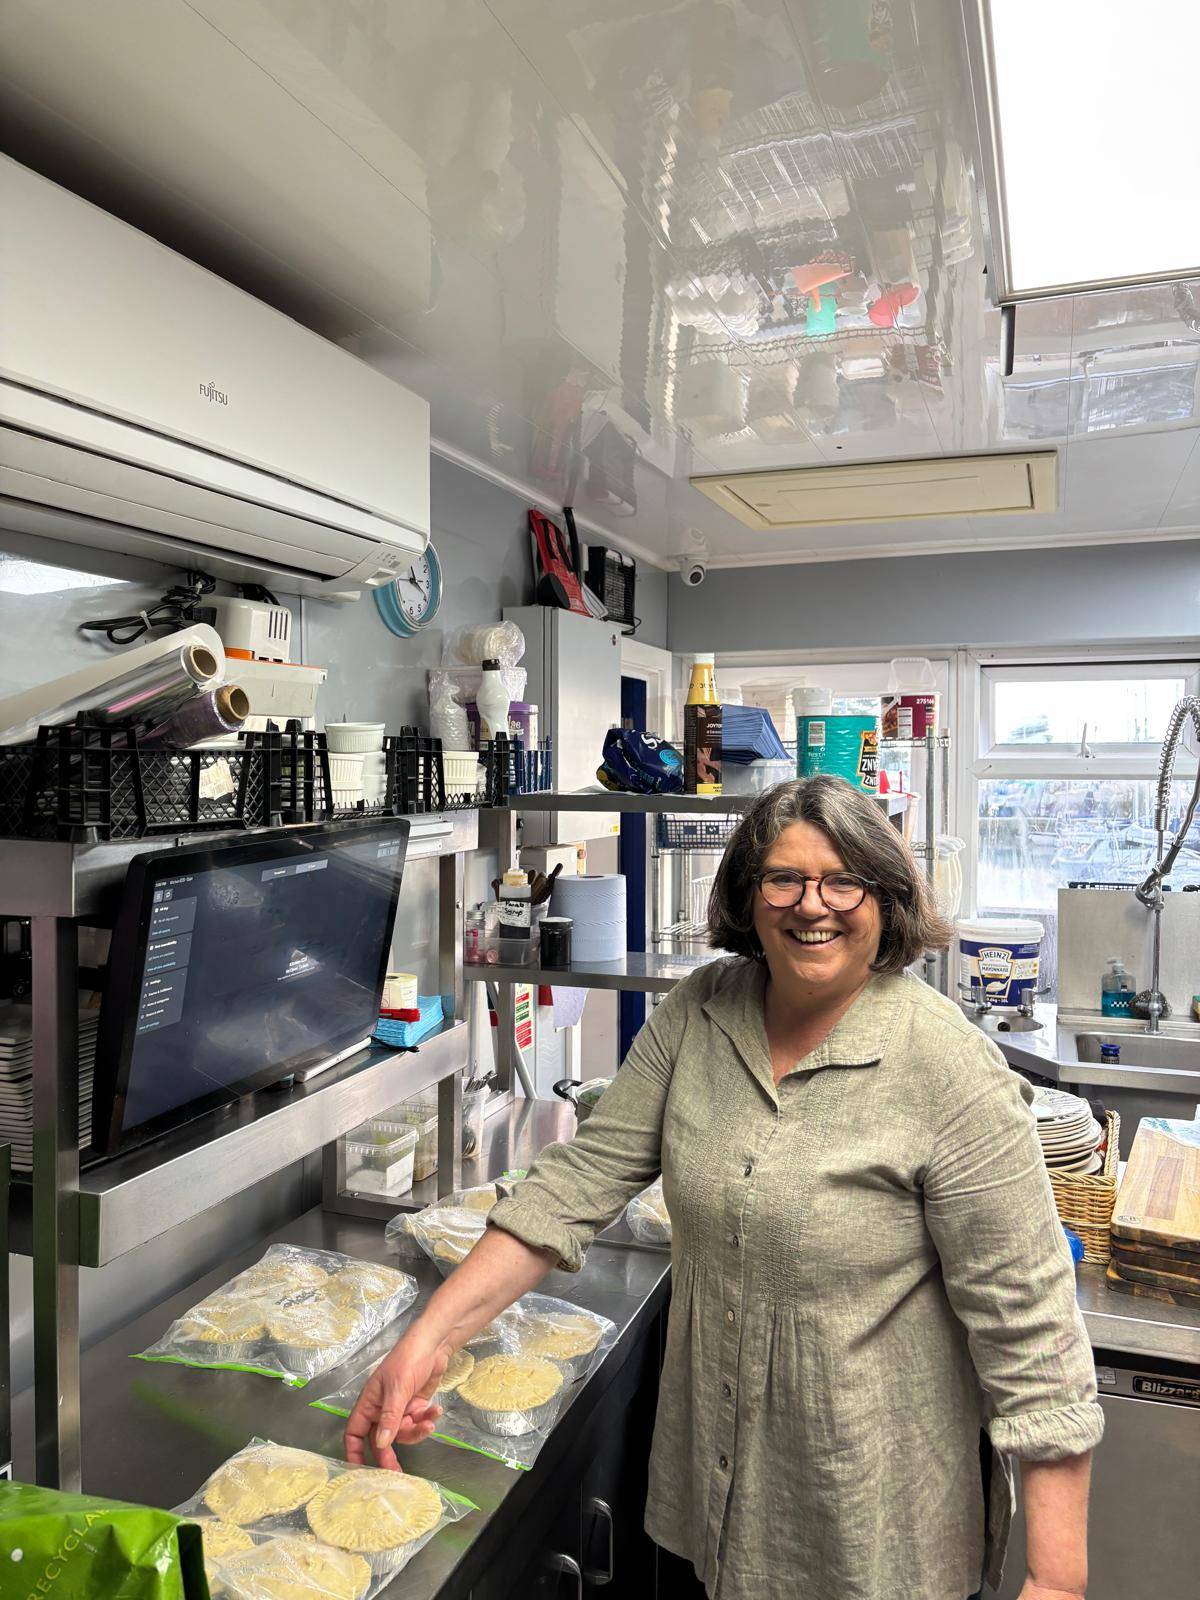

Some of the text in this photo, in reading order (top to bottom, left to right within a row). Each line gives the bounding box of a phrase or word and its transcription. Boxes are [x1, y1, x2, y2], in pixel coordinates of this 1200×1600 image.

[199, 382, 228, 406] FUJITSU
[504, 908, 523, 917] Syrup
[984, 951, 1007, 961] HEINZ
